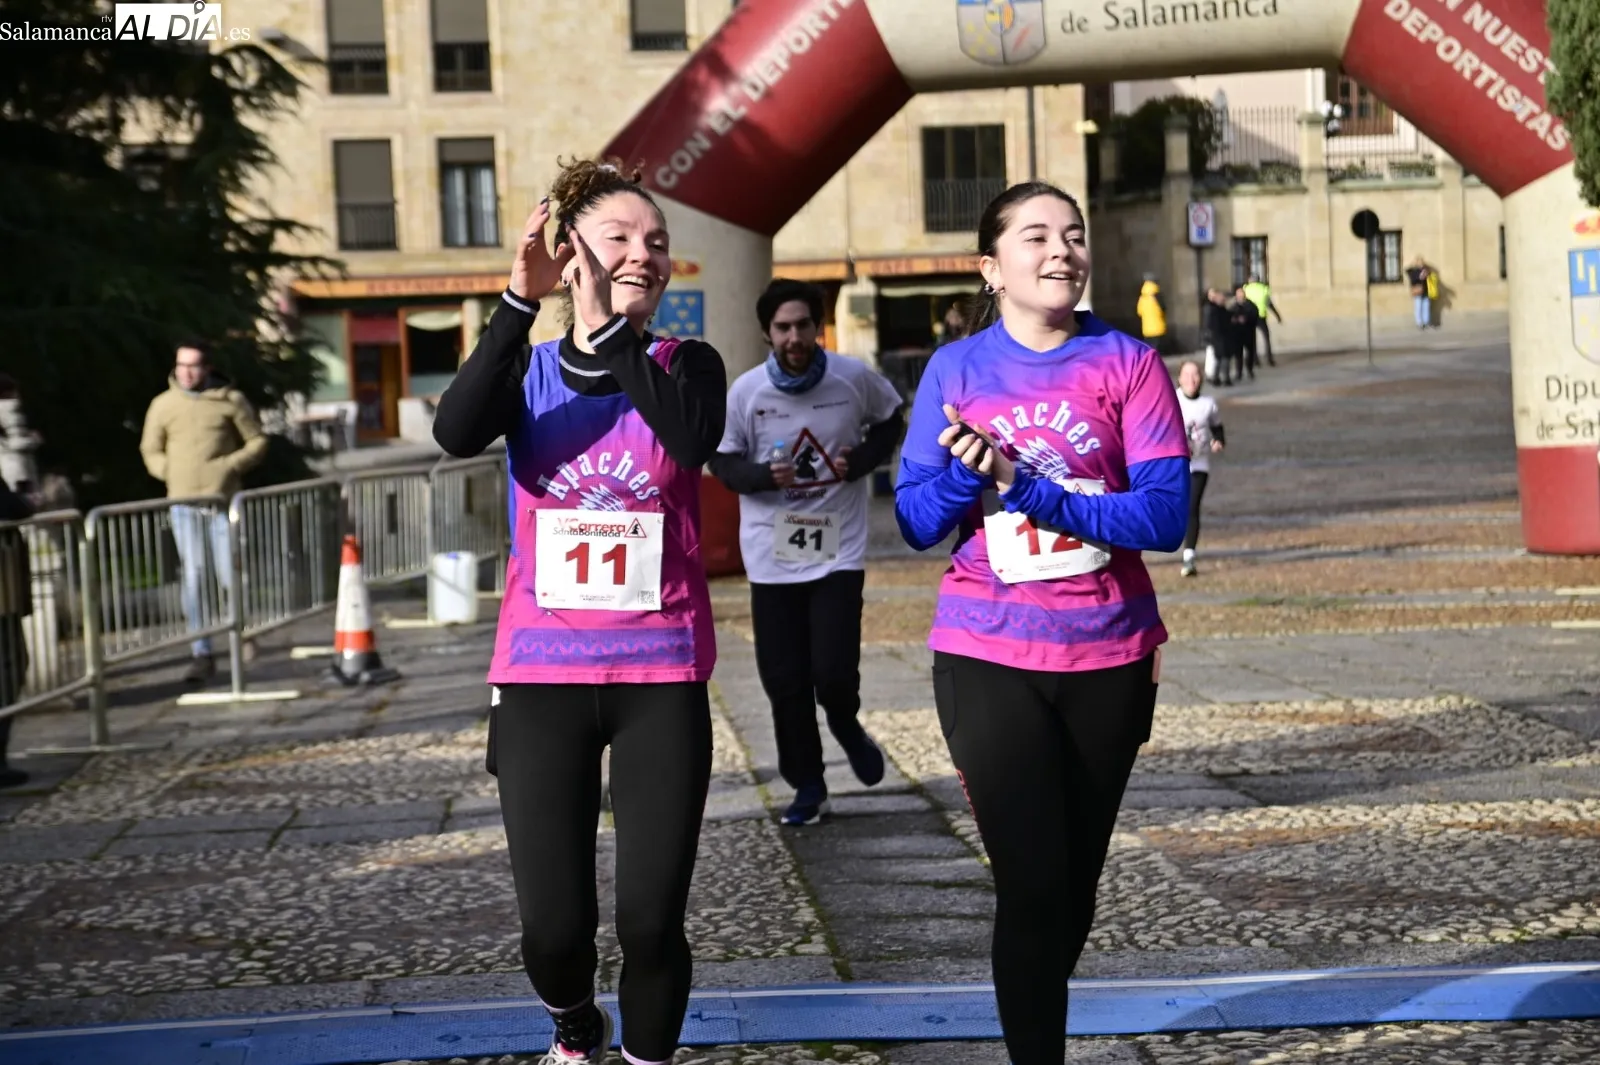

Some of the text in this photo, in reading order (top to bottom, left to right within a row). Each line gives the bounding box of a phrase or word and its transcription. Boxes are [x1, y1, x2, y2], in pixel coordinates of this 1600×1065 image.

[1060, 0, 1280, 34] de Salamanca
[655, 0, 852, 189] CON EL DEPORT
[1383, 0, 1573, 151] DEPORTISTAS
[989, 399, 1101, 456] paches
[1536, 416, 1554, 441] de
[537, 450, 660, 501] Apaches
[788, 528, 823, 551] 41
[565, 542, 627, 585] 11
